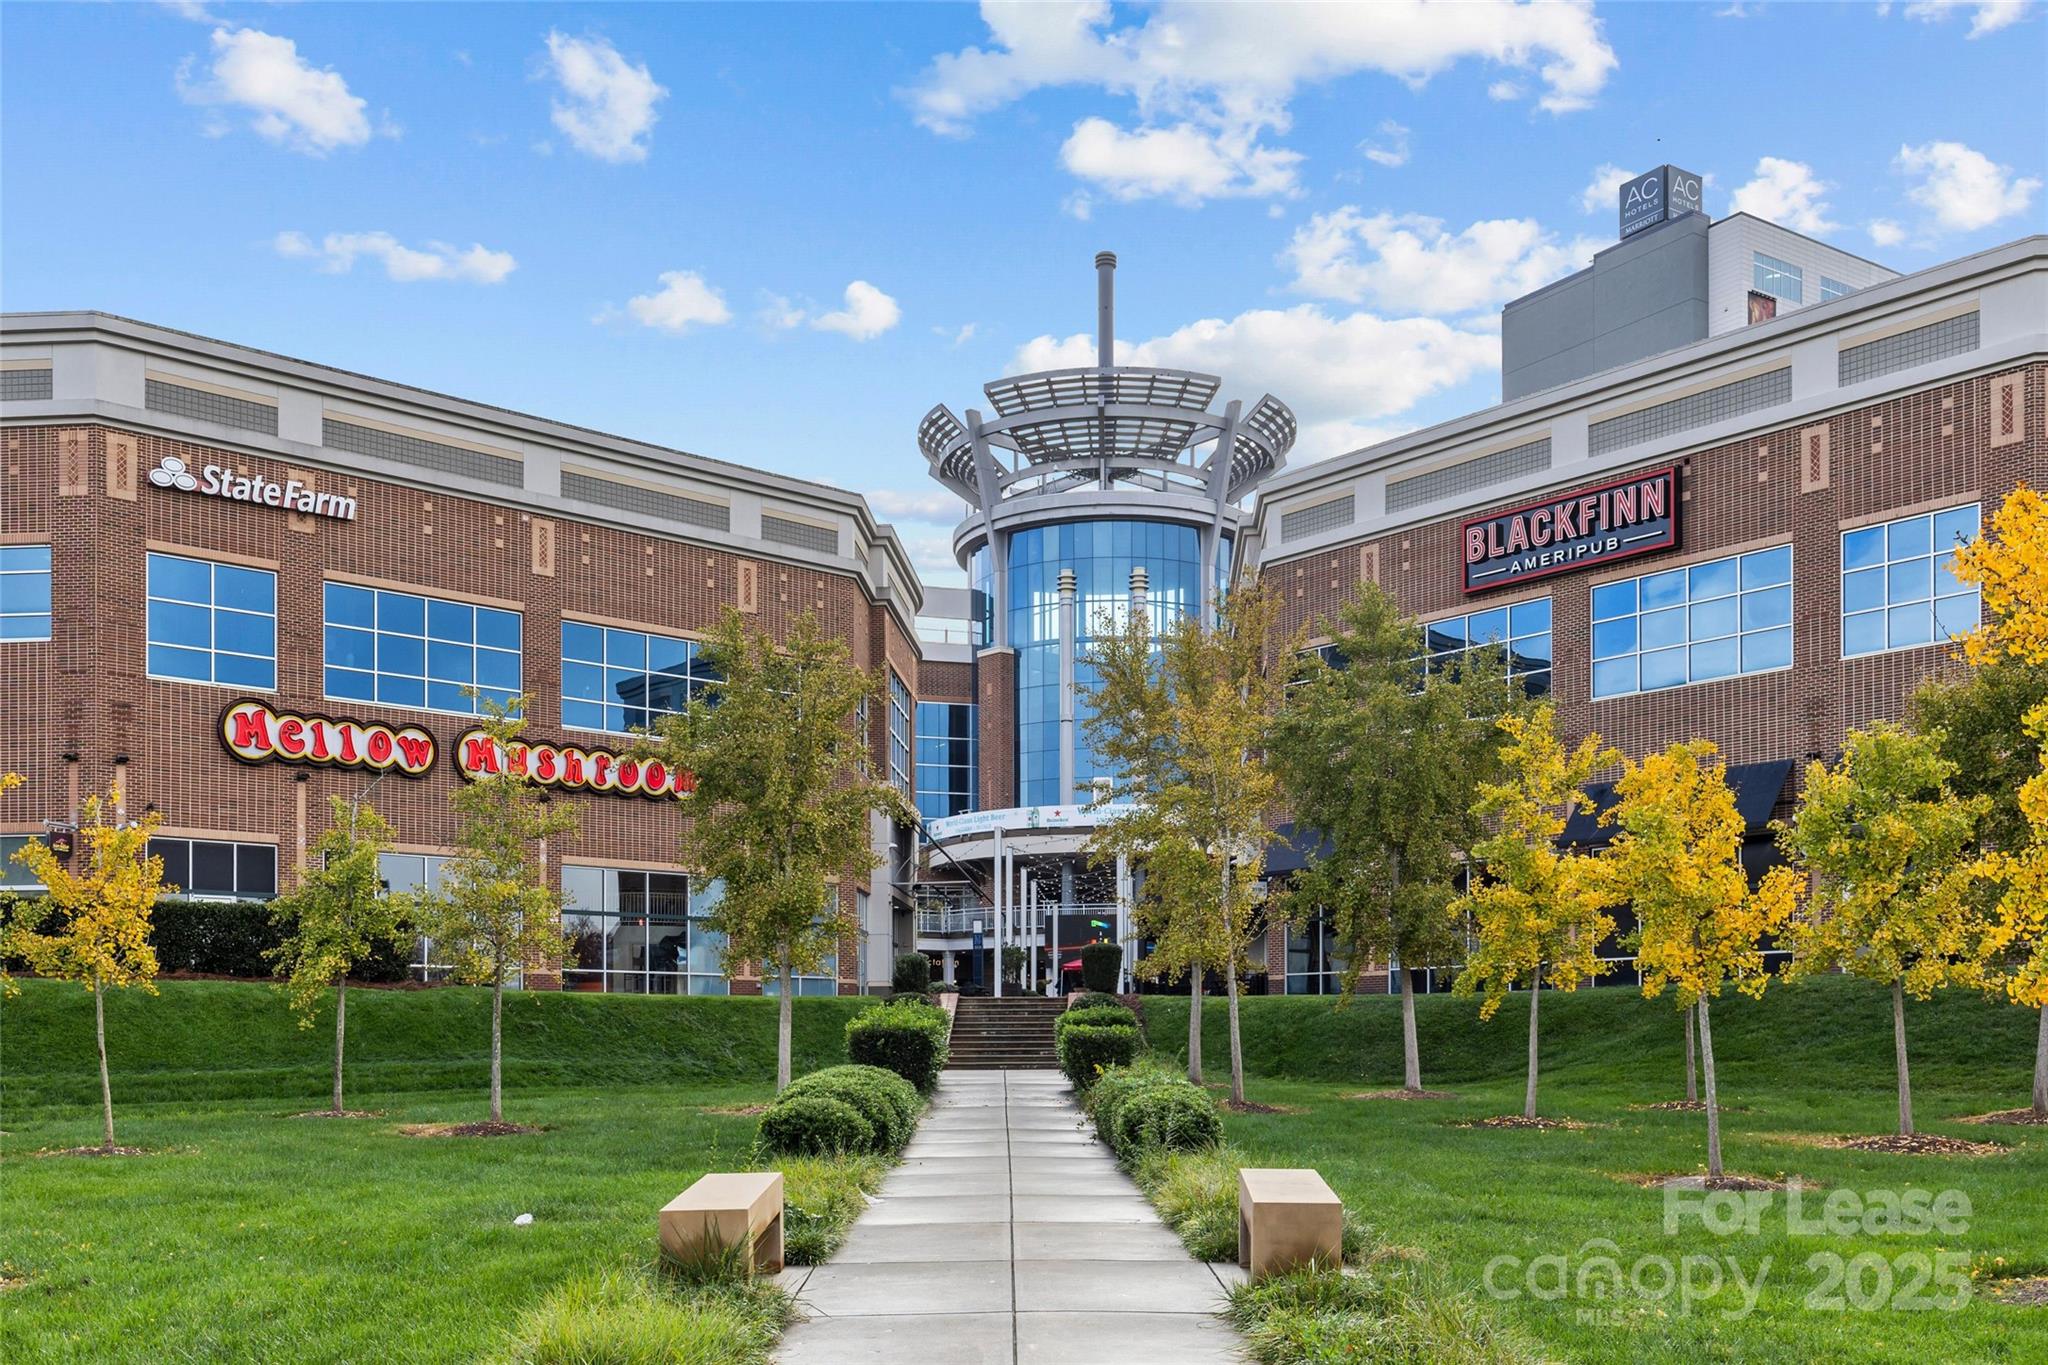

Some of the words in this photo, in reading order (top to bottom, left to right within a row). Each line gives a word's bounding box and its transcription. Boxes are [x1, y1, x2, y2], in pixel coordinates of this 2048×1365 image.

[1625, 177, 1658, 209] AC
[1673, 176, 1699, 200] AC
[1625, 199, 1658, 218] HOTELS
[1672, 197, 1699, 211] HOTELS
[1625, 214, 1658, 234] MARRIOTT
[1466, 478, 1665, 564] BLACKFINN
[1510, 537, 1619, 574] AMERIPUB
[233, 709, 432, 769] Mellow
